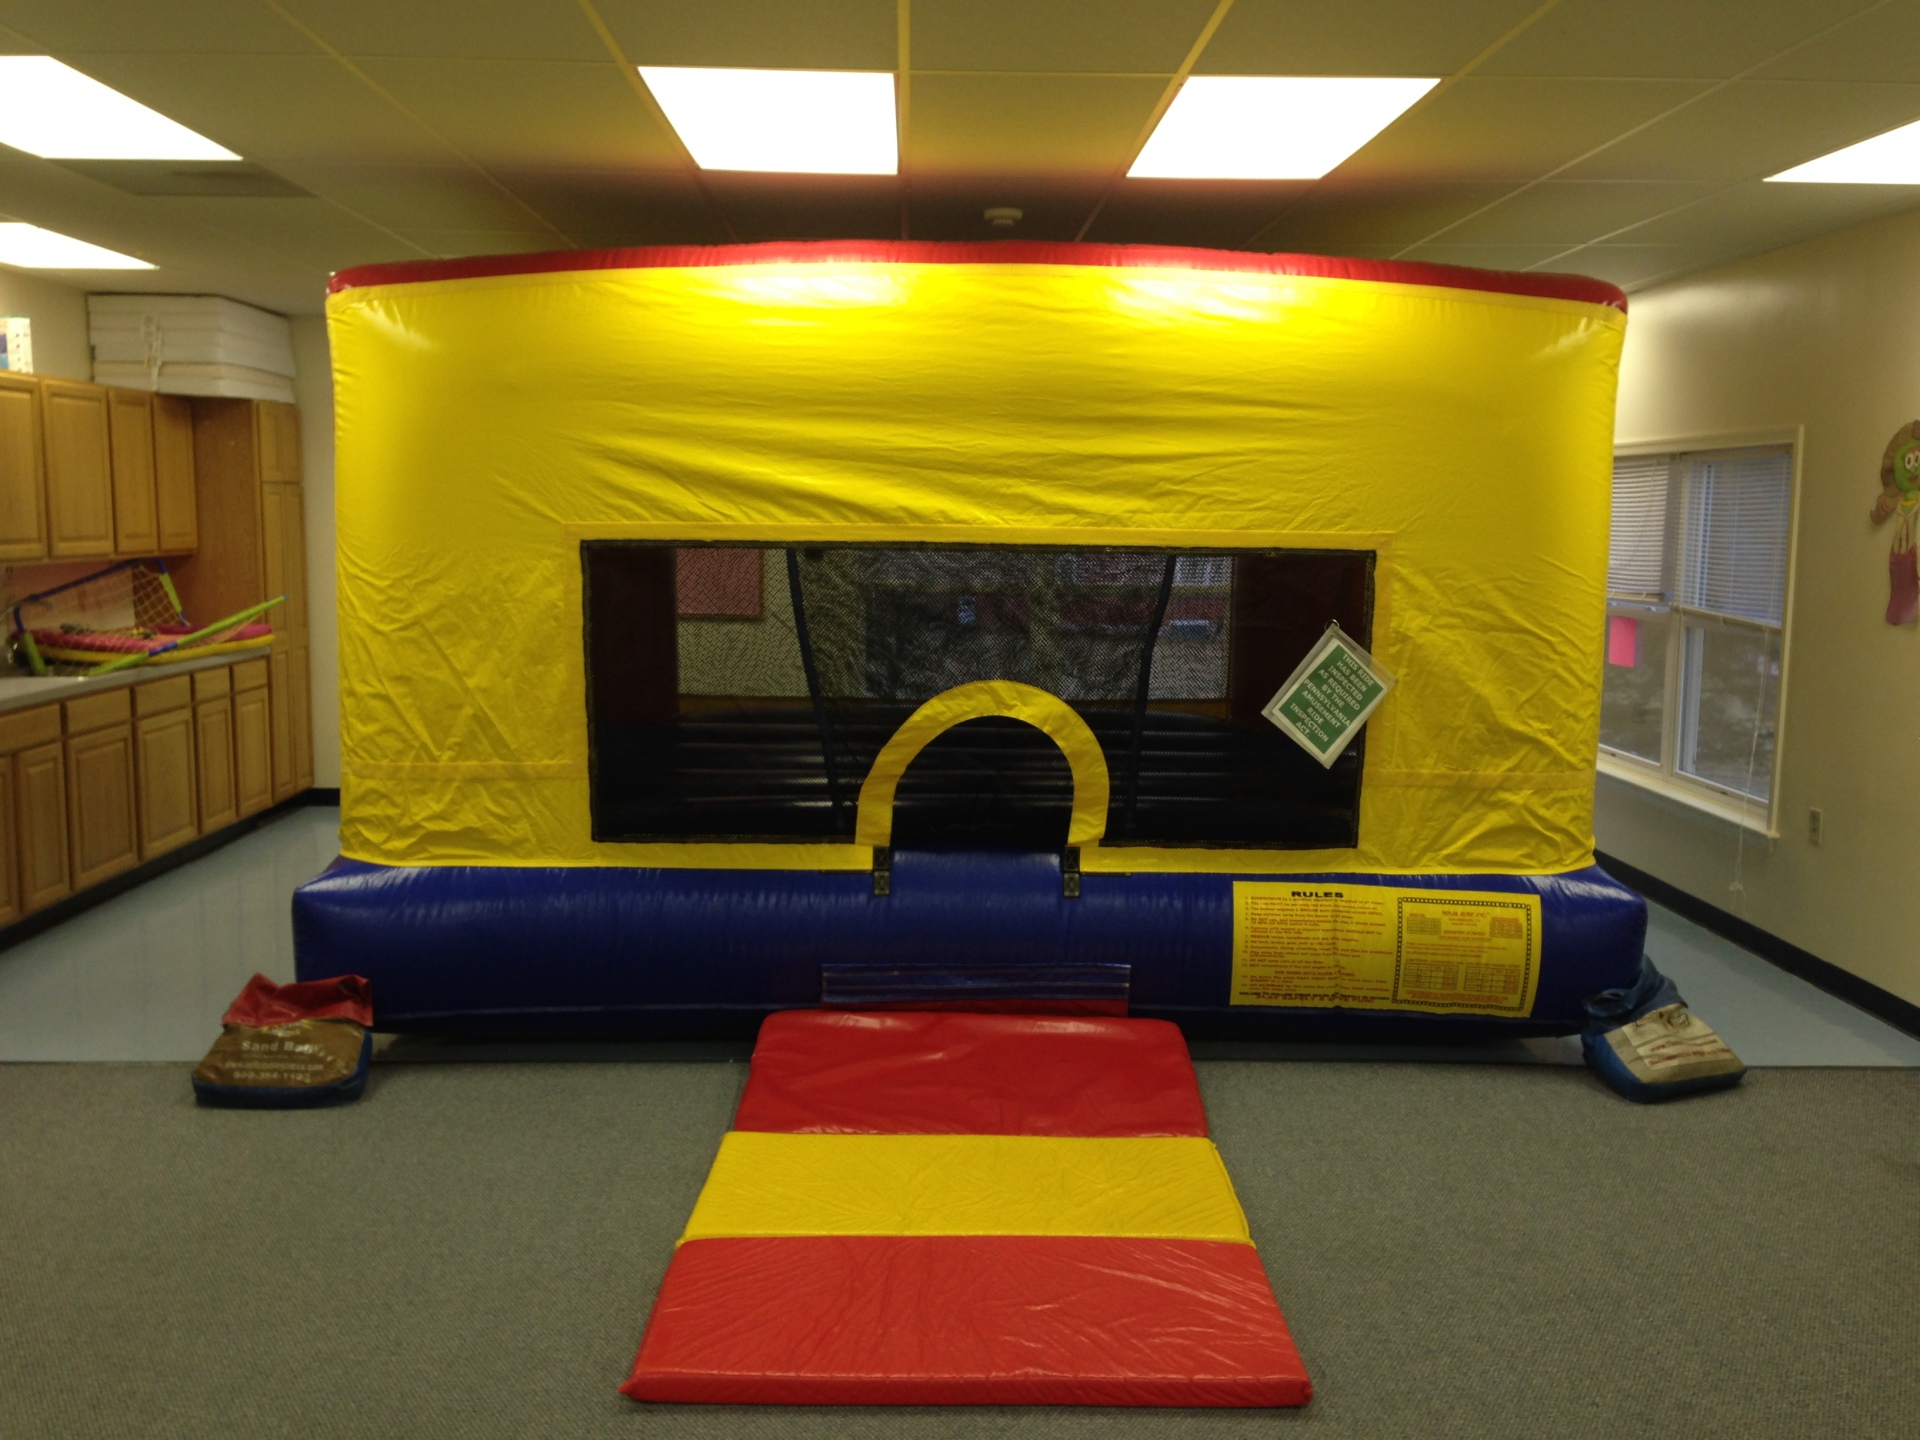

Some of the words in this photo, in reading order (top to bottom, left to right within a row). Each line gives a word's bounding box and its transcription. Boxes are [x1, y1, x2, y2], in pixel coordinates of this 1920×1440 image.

[1328, 666, 1363, 701] INSPECTED
[1337, 661, 1352, 675] HAS
[1349, 673, 1368, 692] BEEN
[1343, 654, 1359, 671] THIS
[1358, 669, 1375, 687] RIDE
[1304, 679, 1351, 727] PENNSYLVANIA
[1318, 669, 1330, 680] AS
[1328, 678, 1361, 711] REQUIRED
[1321, 684, 1332, 695] BY
[1331, 692, 1345, 708] THE
[1290, 703, 1330, 742] INSPECTION
[1302, 690, 1342, 729] AMUSEMENT
[1307, 707, 1325, 725] RIDE
[1295, 721, 1310, 738] ACT.
[241, 1040, 279, 1051] Sand
